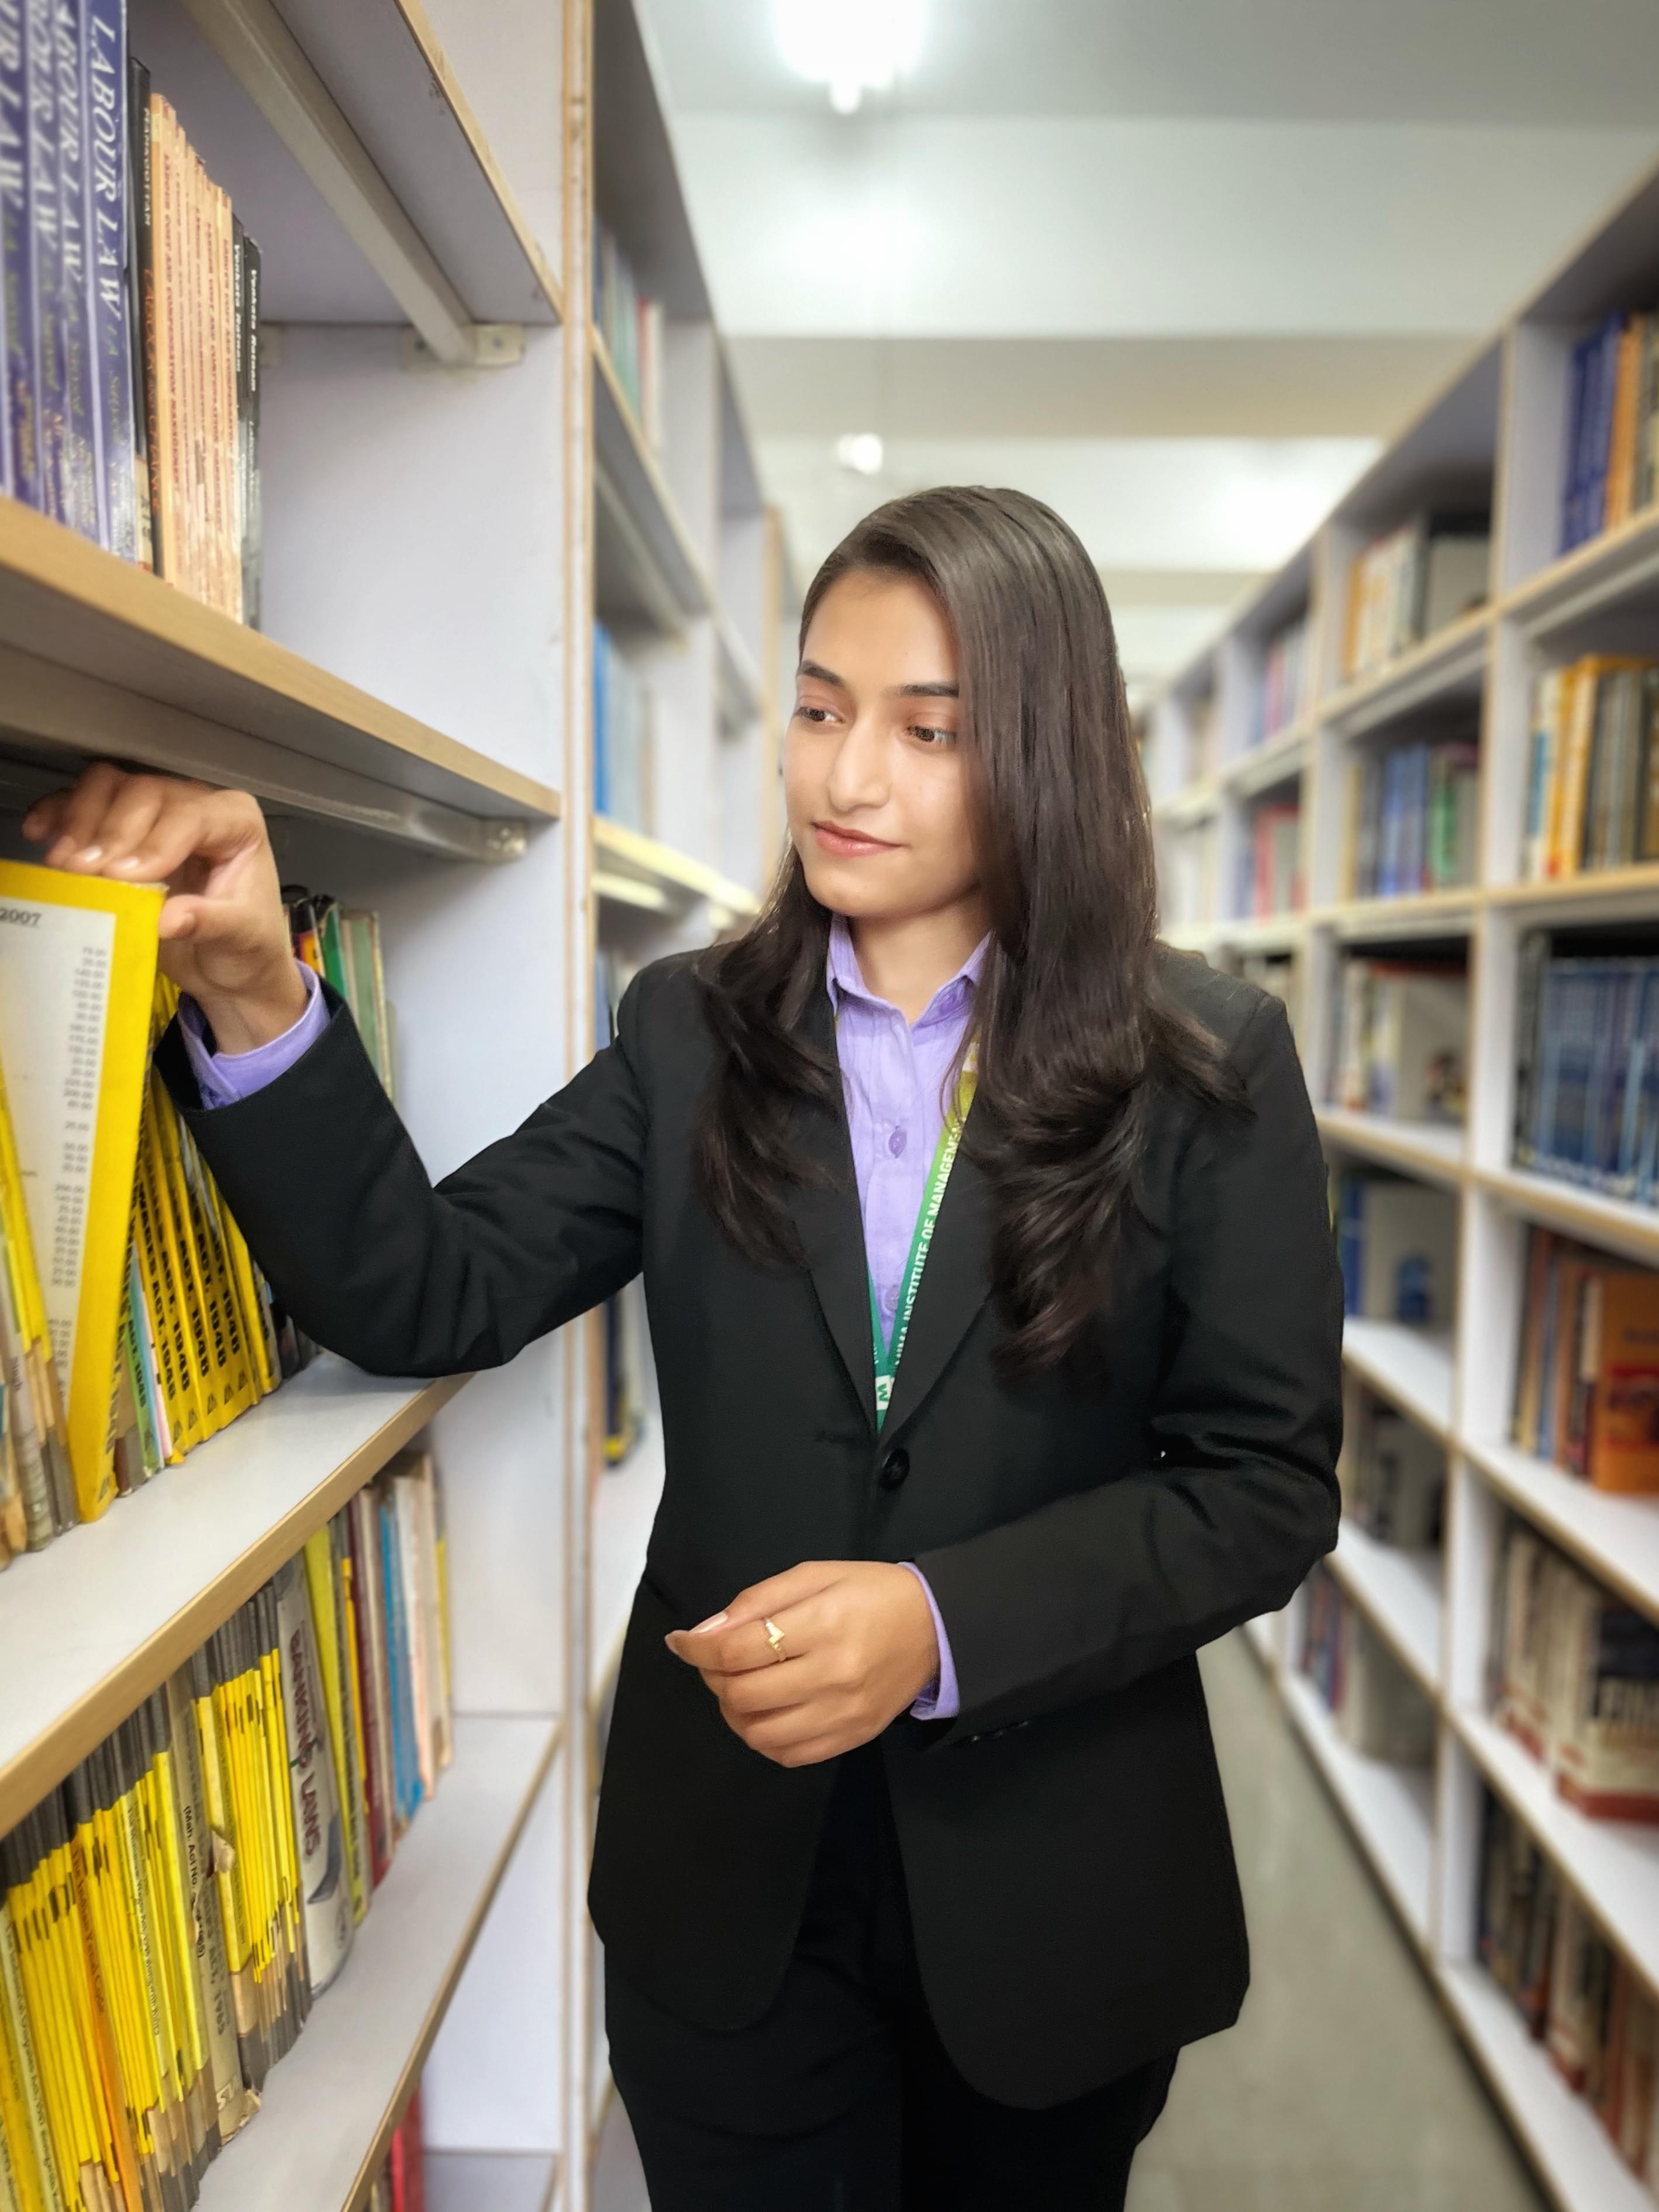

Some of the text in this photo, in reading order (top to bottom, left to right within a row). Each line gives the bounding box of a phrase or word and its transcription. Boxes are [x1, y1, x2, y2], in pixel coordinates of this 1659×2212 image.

[92, 16, 116, 203] LABOUR
[61, 175, 82, 282] LAW
[164, 214, 173, 251] COST
[96, 208, 122, 320] LAW
[165, 253, 174, 282] AND
[0, 906, 42, 926] 2007
[139, 1182, 156, 1275] WAGES
[161, 1340, 176, 1400] 1948
[903, 1243, 930, 1321] INSTITUTE
[921, 1219, 936, 1240] OF
[173, 1321, 190, 1392] 1948
[192, 1308, 209, 1377] 1948
[209, 1300, 226, 1368] 1948
[222, 1289, 240, 1355] 1948
[135, 1363, 146, 1407] 1948
[290, 1628, 313, 1770] BANKING
[184, 1806, 192, 1840] (Mah.
[188, 1844, 196, 1866] Act
[301, 1772, 320, 1858] LAWS
[131, 1828, 140, 1880] Minimum
[71, 1848, 104, 2013] The Indian Penal Code
[134, 1880, 144, 1914] Wages
[11, 1949, 25, 2014] Industrial
[23, 2017, 34, 2072] Disputes
[213, 1989, 225, 2036] 1965
